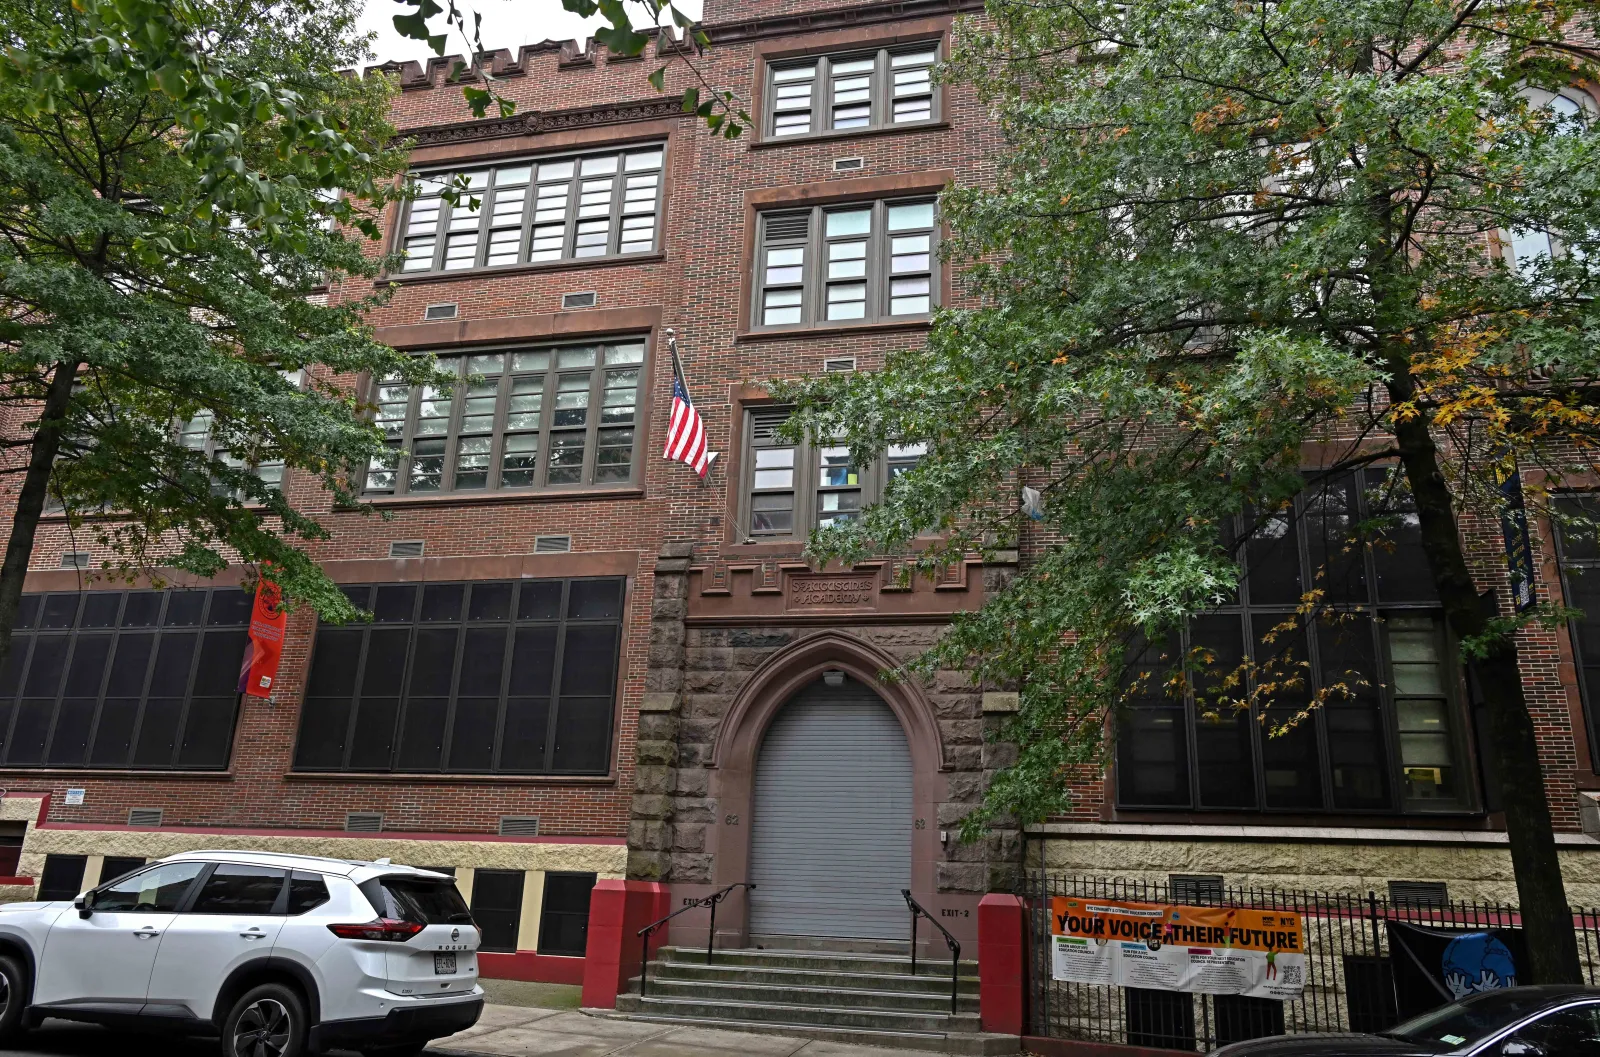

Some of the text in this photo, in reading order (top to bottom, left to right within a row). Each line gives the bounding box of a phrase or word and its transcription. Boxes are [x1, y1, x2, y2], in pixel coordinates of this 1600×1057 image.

[801, 593, 861, 604] ACADEMY
[725, 814, 738, 825] 62
[1057, 915, 1104, 935] YOUR
[1171, 925, 1224, 944] THEIR
[1230, 928, 1298, 949] FUTURE
